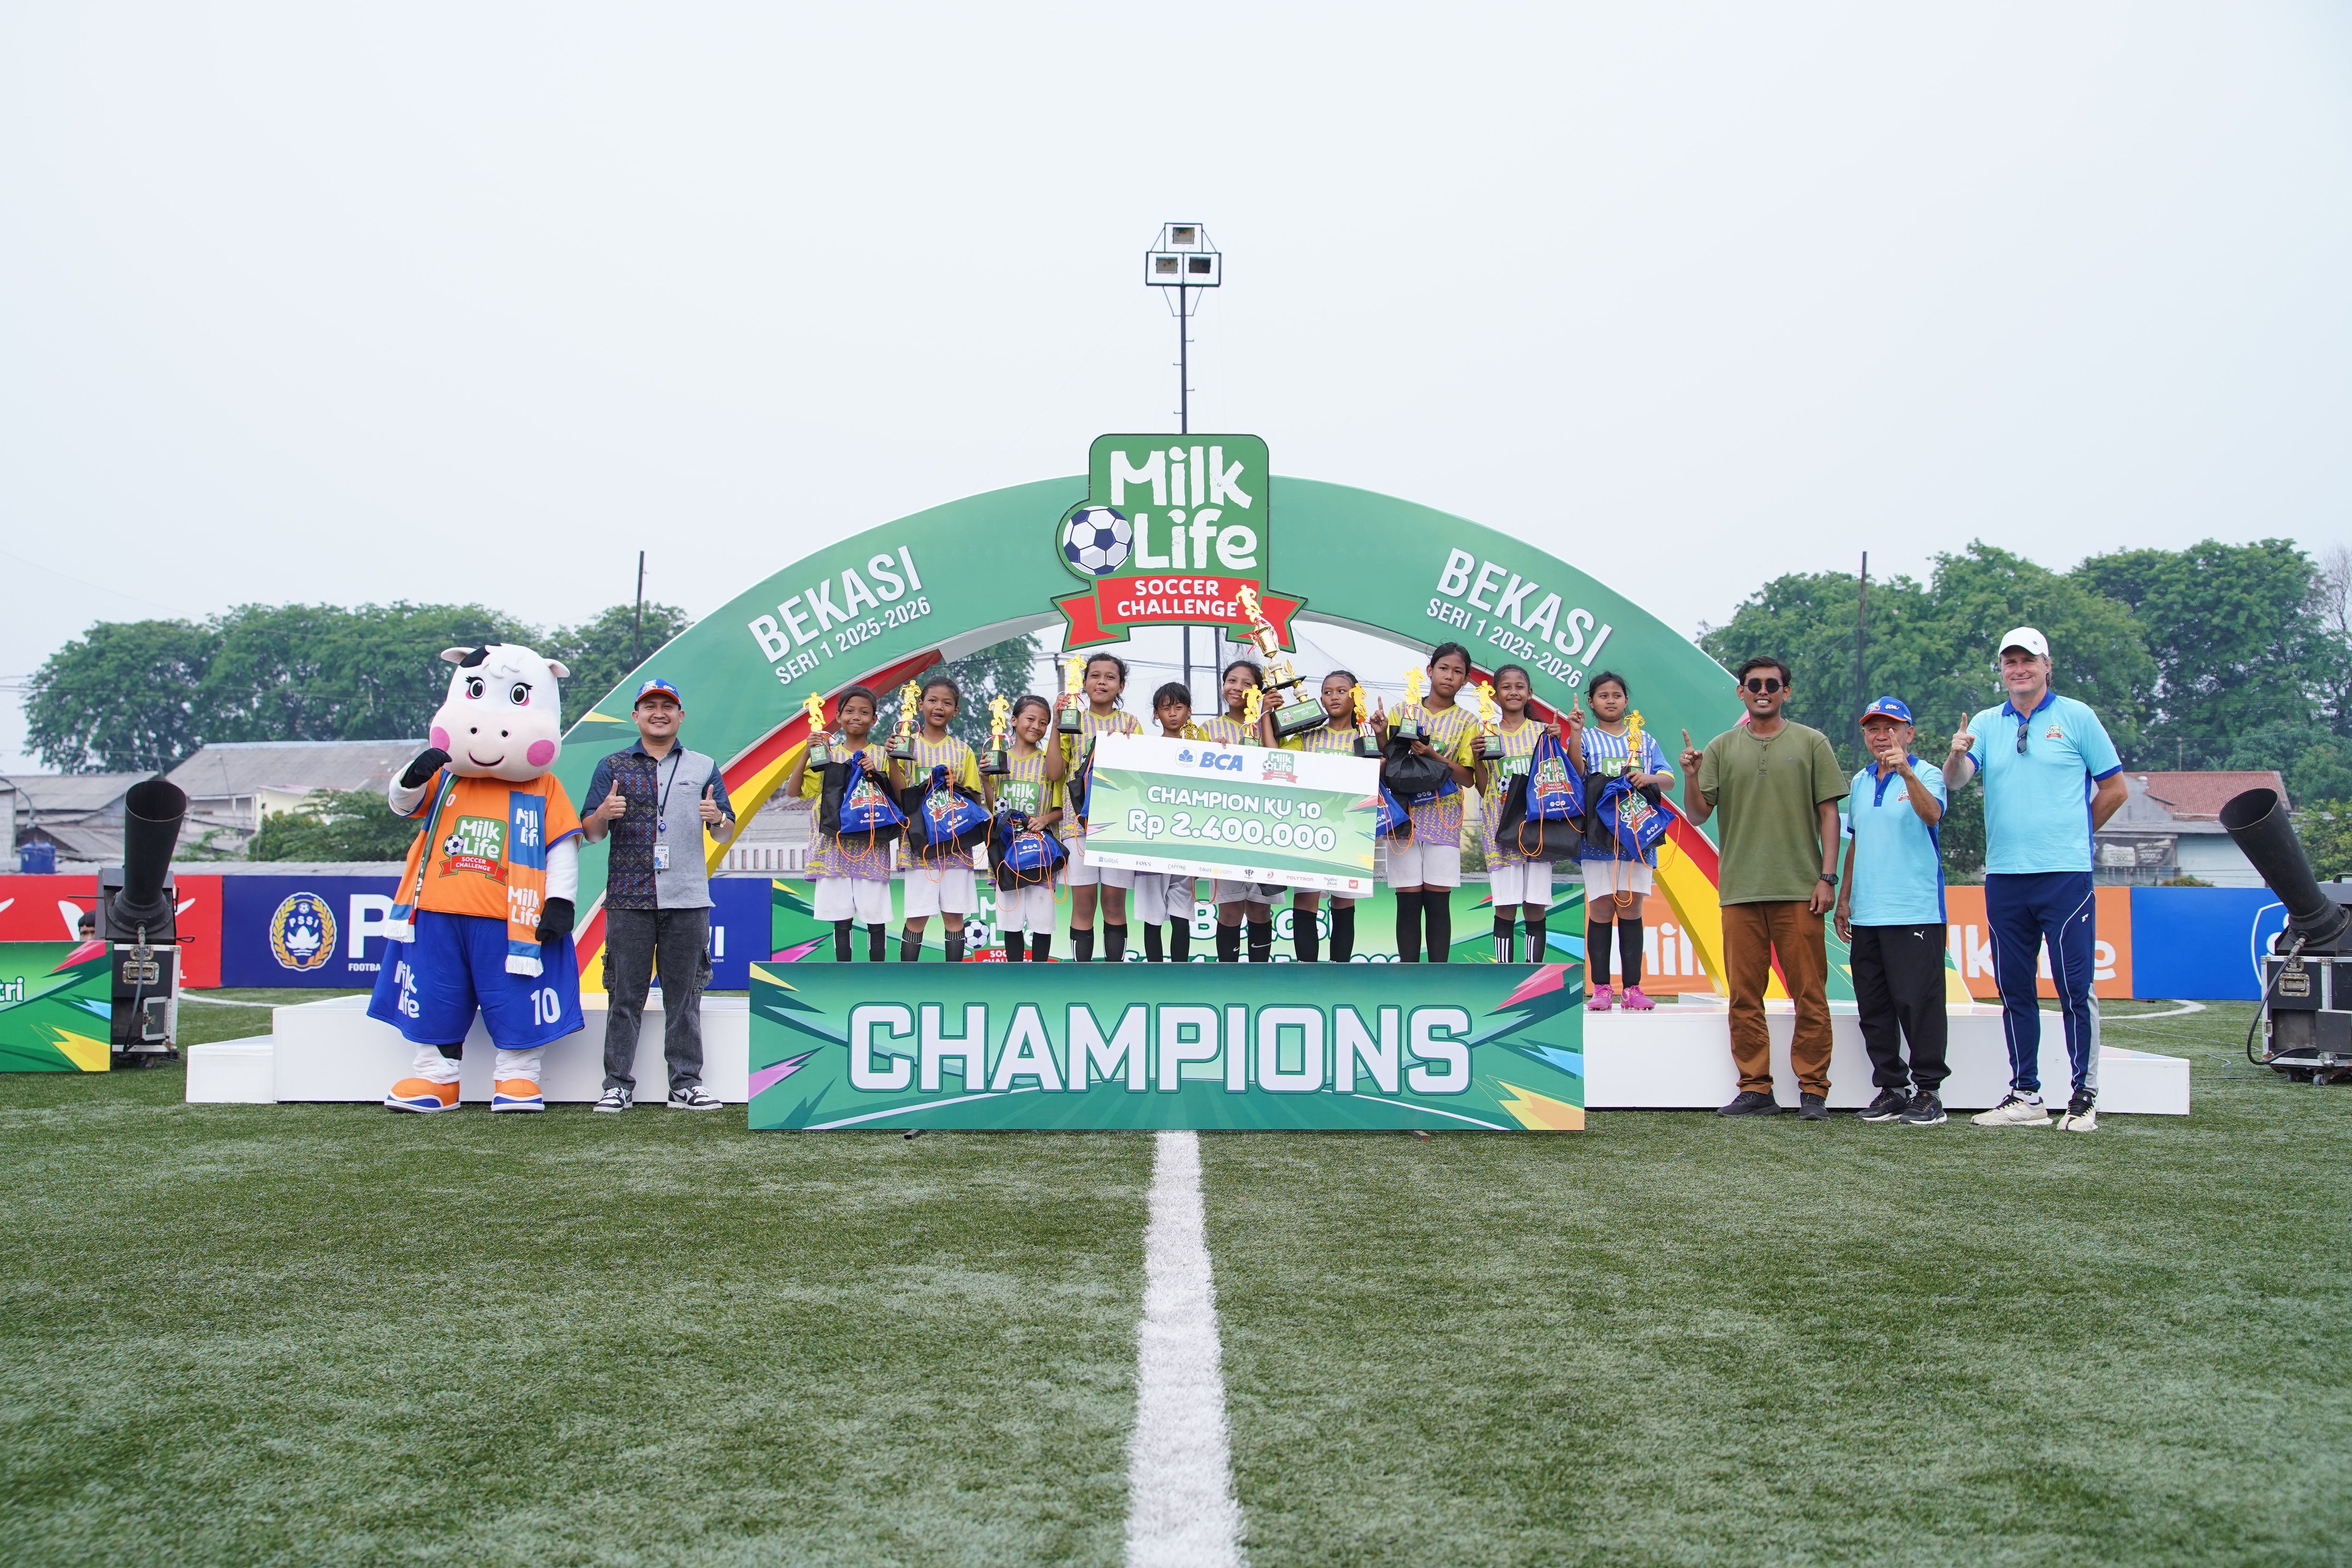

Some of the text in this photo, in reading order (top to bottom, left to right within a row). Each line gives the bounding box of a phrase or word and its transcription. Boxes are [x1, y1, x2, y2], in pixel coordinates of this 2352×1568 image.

[1111, 446, 1252, 509] Milk
[1134, 509, 1257, 570] Life
[1135, 579, 1219, 596] SOCCER
[747, 545, 922, 664] BEKASI
[1117, 600, 1238, 617] CHALLENGE
[1436, 547, 1613, 667] BEKASI
[775, 596, 931, 685] SERI 1 2025-2026
[1427, 597, 1583, 689] SERI 1 2025-2026
[1199, 752, 1243, 771] BCA
[1271, 753, 1292, 763] Milk
[1272, 762, 1292, 772] Life
[1004, 783, 1035, 800] Milk
[1009, 798, 1035, 814] Life
[1147, 785, 1321, 820] CHAMPION KU 10
[459, 820, 500, 841] Milk
[1128, 809, 1336, 851] Rp 2.400.000
[463, 837, 499, 858] Life
[455, 862, 491, 871] CHALLENGE
[289, 916, 319, 928] PSSI
[511, 905, 541, 927] Life
[348, 963, 381, 972] FOOTBA
[531, 987, 562, 1025] 10
[851, 1004, 1471, 1093] CHAMPIONS
